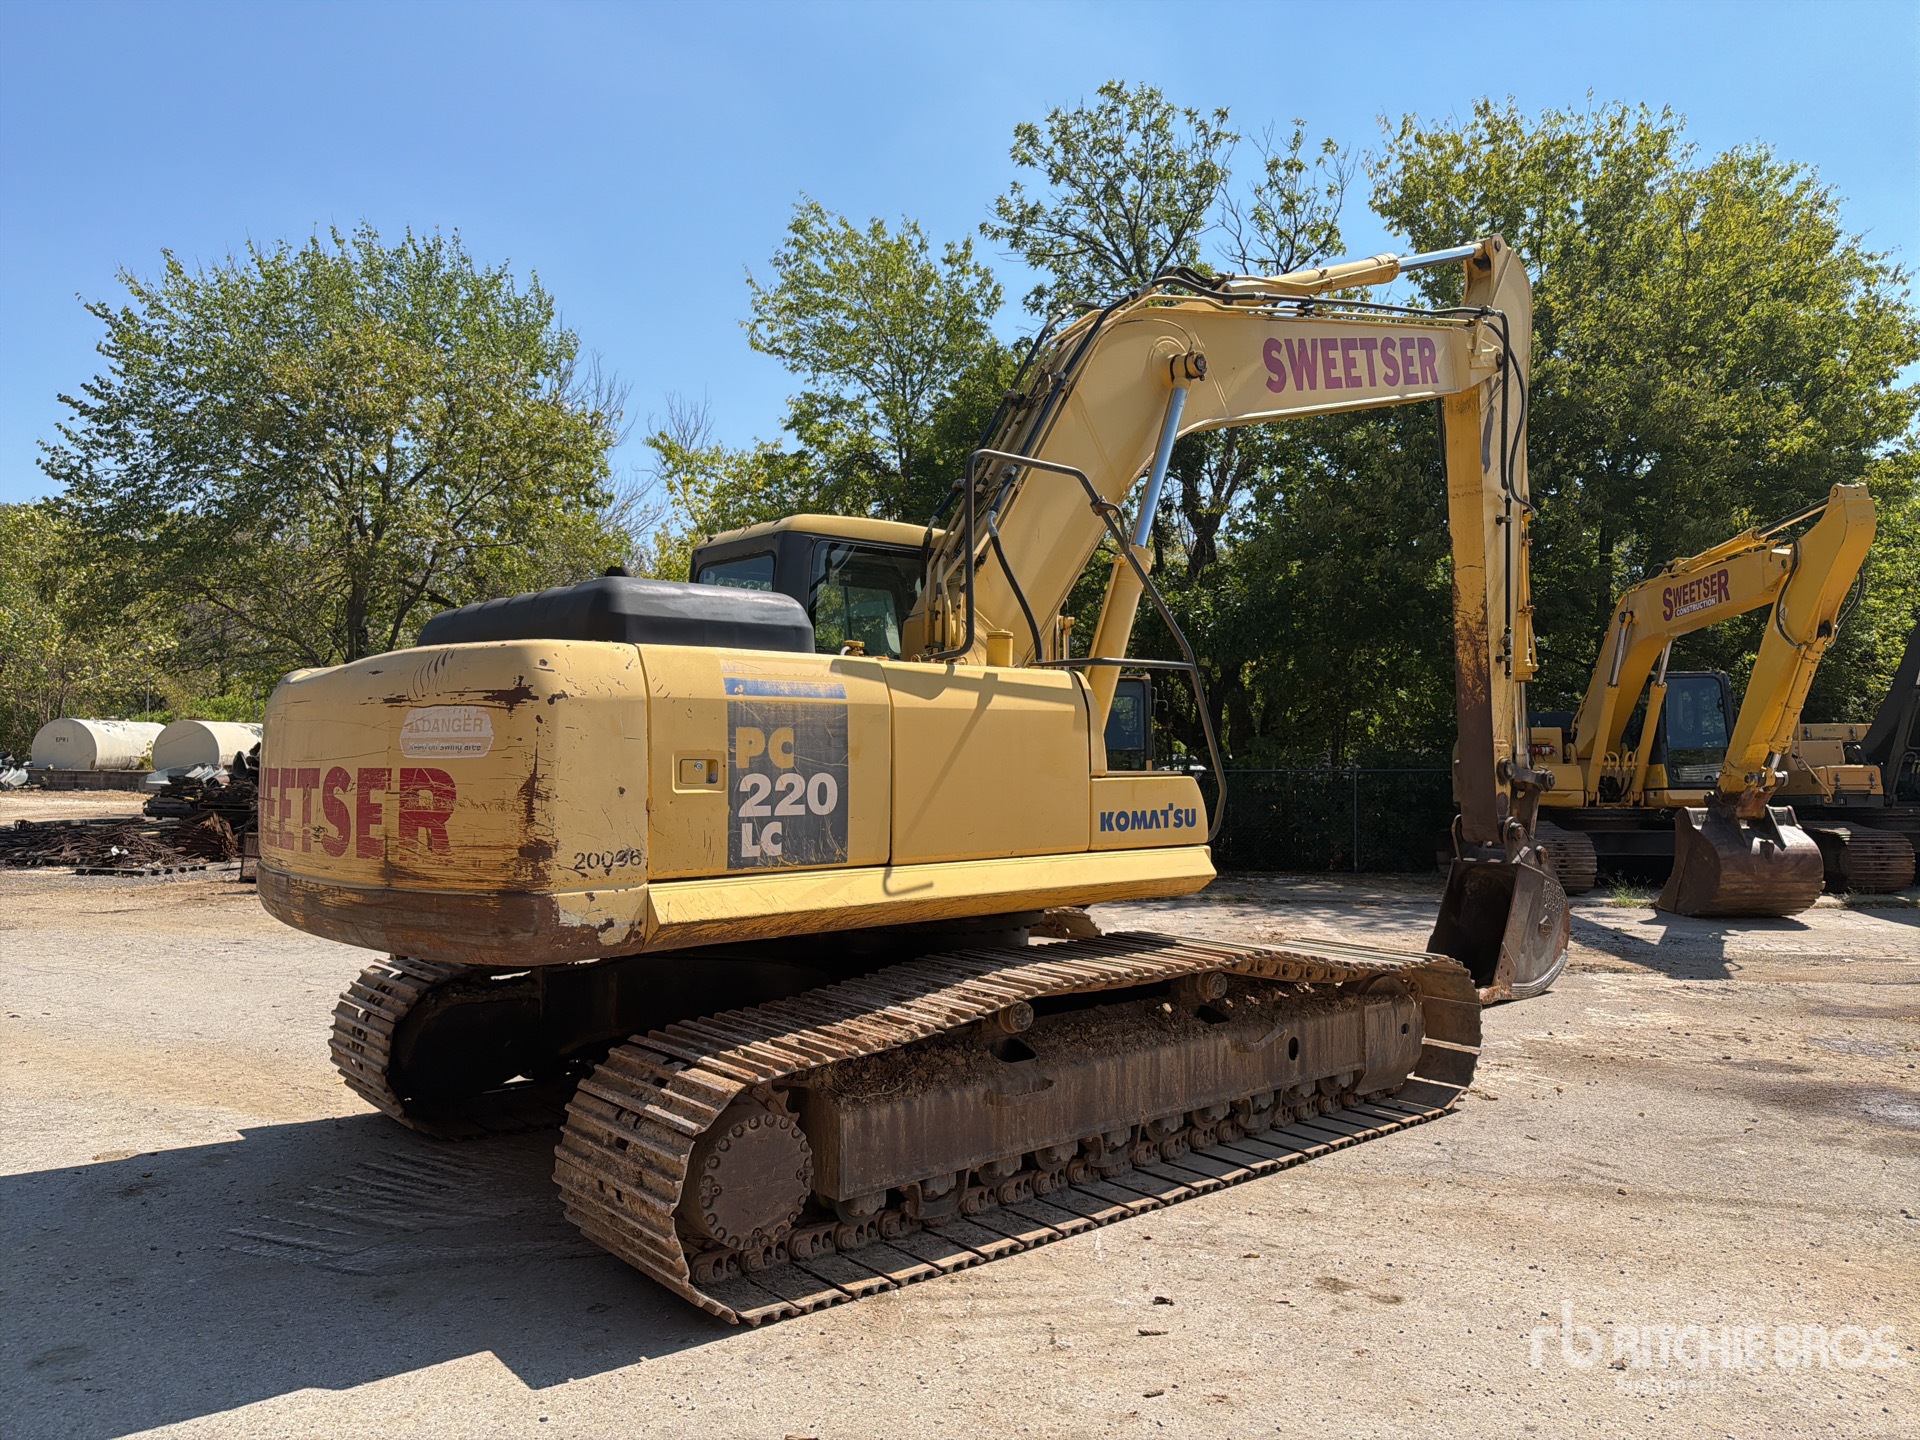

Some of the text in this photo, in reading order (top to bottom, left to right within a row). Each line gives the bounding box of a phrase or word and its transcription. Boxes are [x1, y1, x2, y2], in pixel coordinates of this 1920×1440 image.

[1263, 337, 1439, 393] SWEETSER
[1663, 569, 1730, 621] SWEETSER
[1676, 597, 1716, 617] CONSTRUCTION
[422, 717, 483, 733] DANGER
[736, 727, 794, 768] PC
[738, 773, 838, 817] 220
[1100, 803, 1197, 832] KOMATSU
[741, 822, 782, 857] LC
